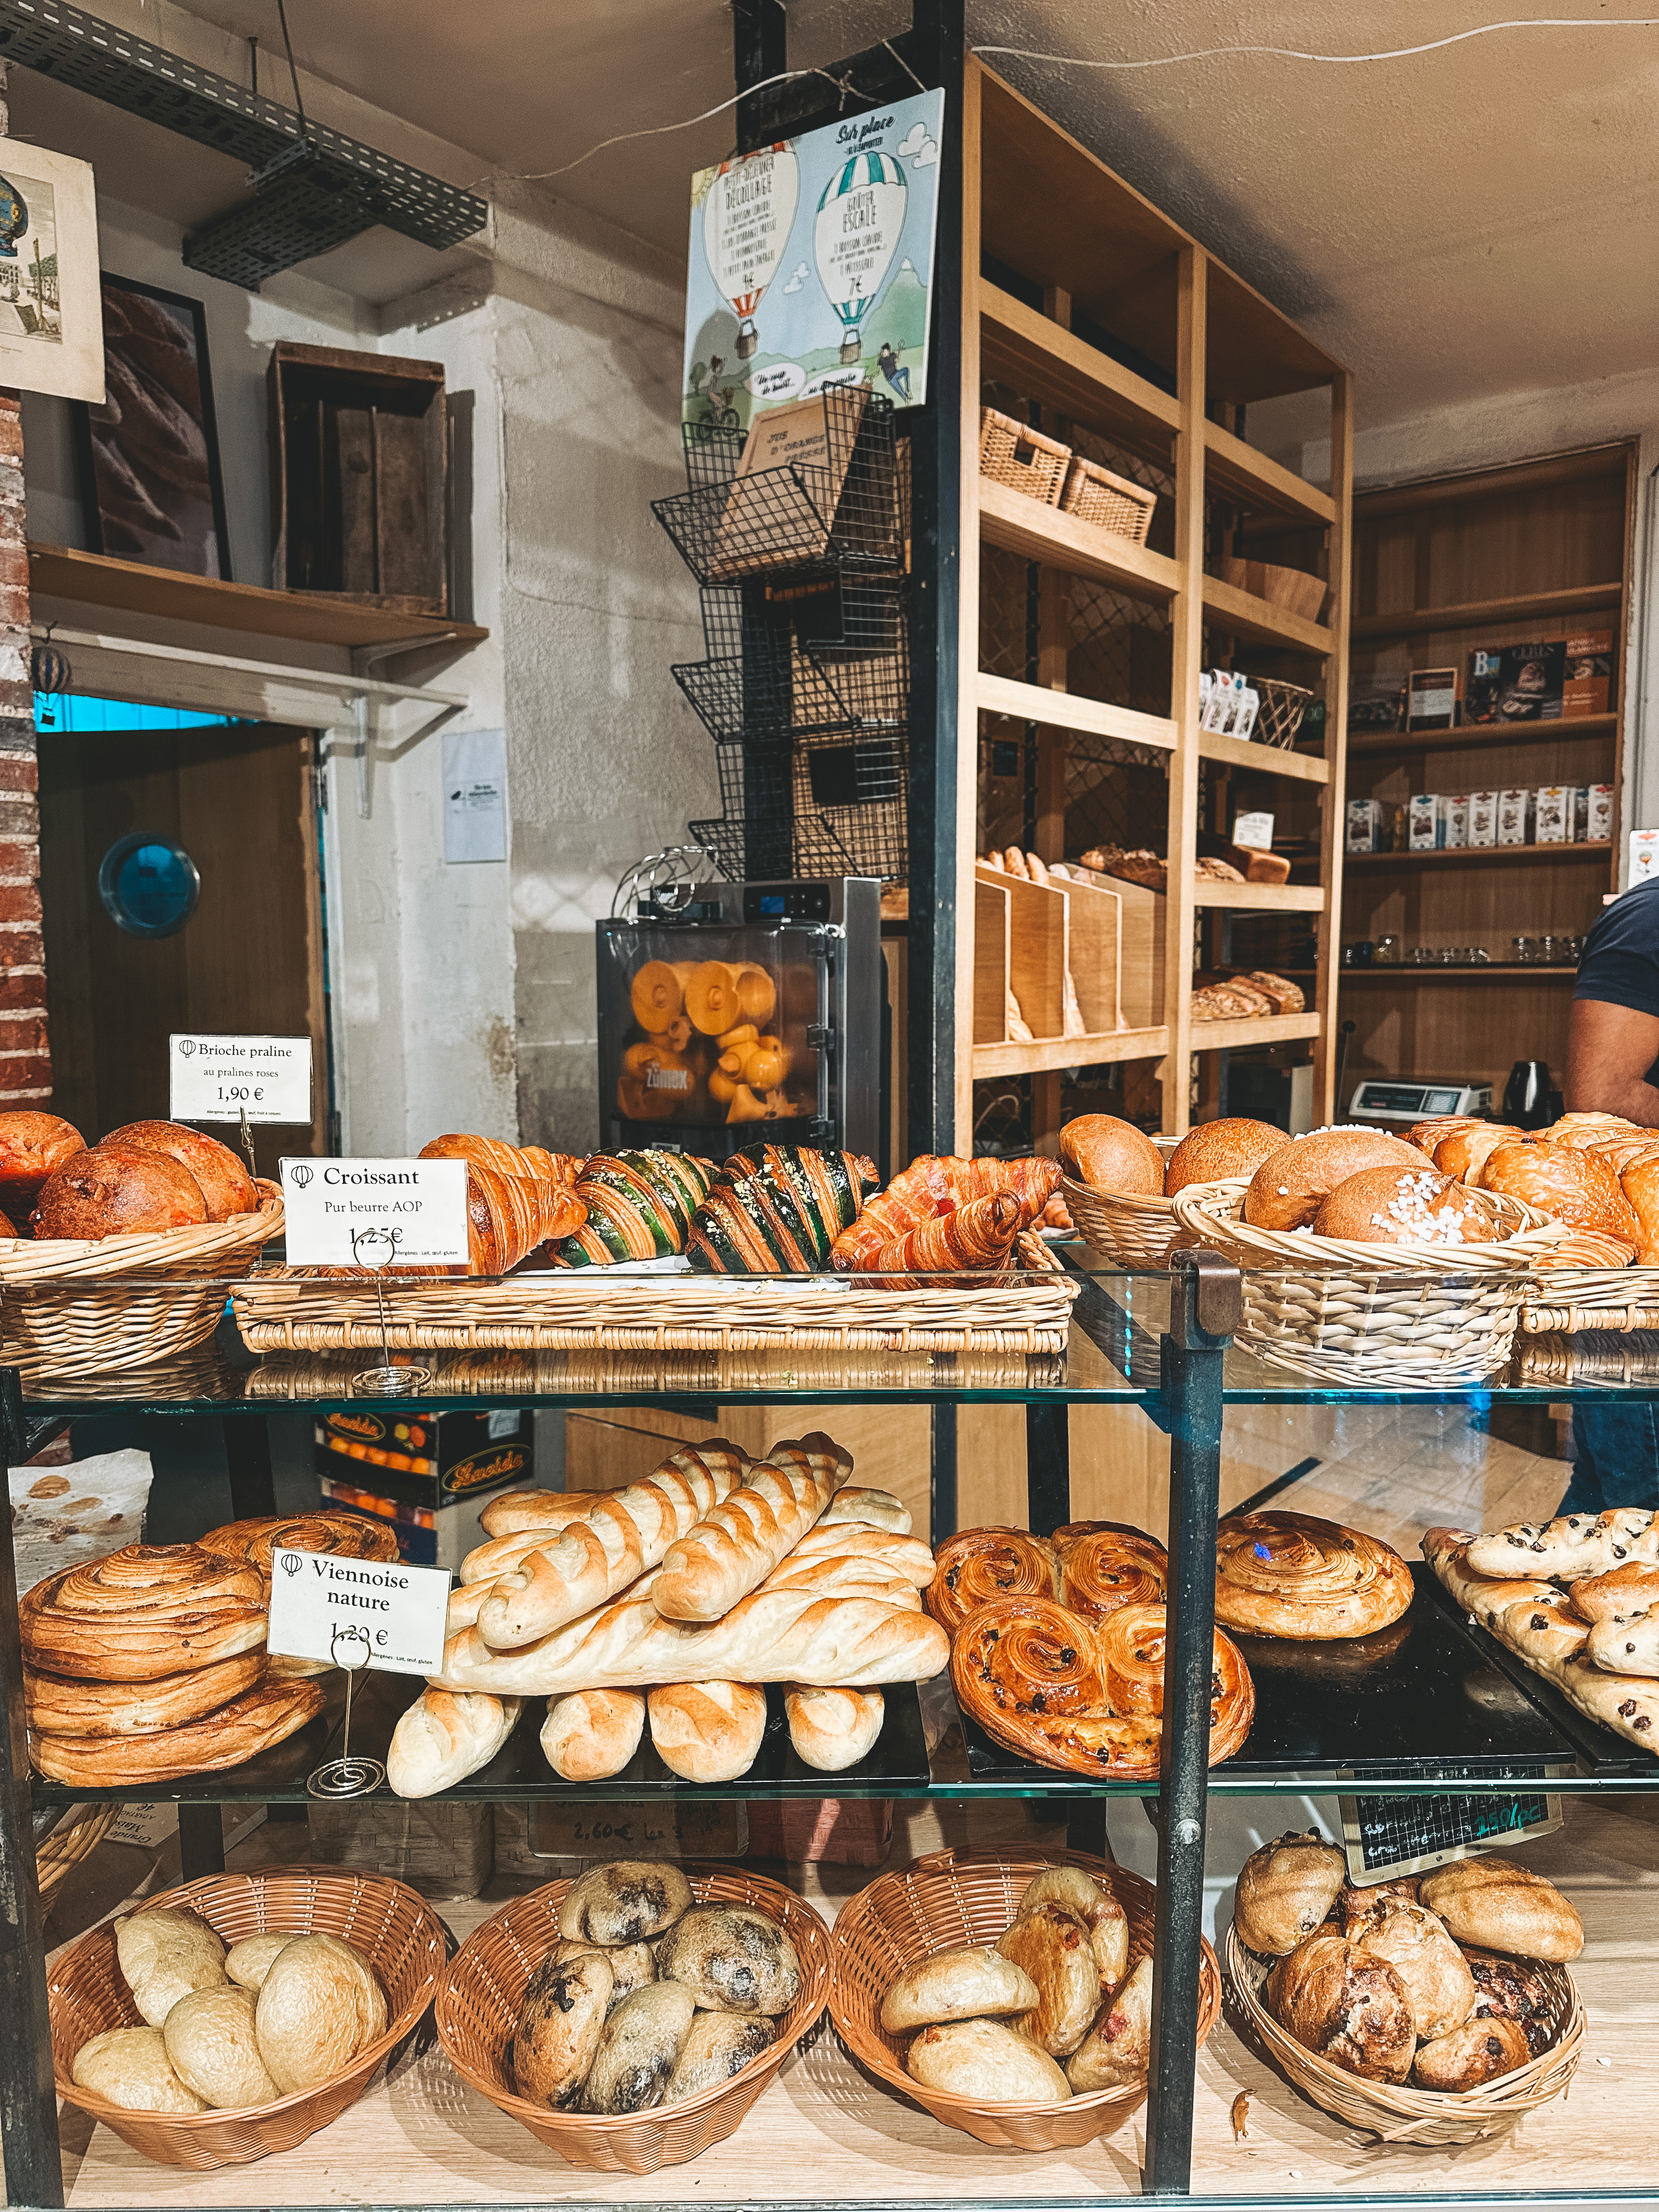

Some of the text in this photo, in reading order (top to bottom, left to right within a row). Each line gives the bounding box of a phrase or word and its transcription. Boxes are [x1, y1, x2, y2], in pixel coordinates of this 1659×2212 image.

[836, 116, 895, 144] Sur place
[843, 205, 877, 233] ESCALE
[849, 275, 862, 296] 7€
[199, 1043, 292, 1058] Brioche praline
[217, 1067, 253, 1078] pralines
[217, 1087, 264, 1102] 1,90 €
[324, 1167, 420, 1184] Croissant
[325, 1201, 422, 1212] Pur beurre AOP
[312, 1559, 409, 1589] Viennoise
[327, 1591, 390, 1611] nature
[330, 1622, 388, 1646] 1,20 €
[110, 1831, 152, 1843] Grande
